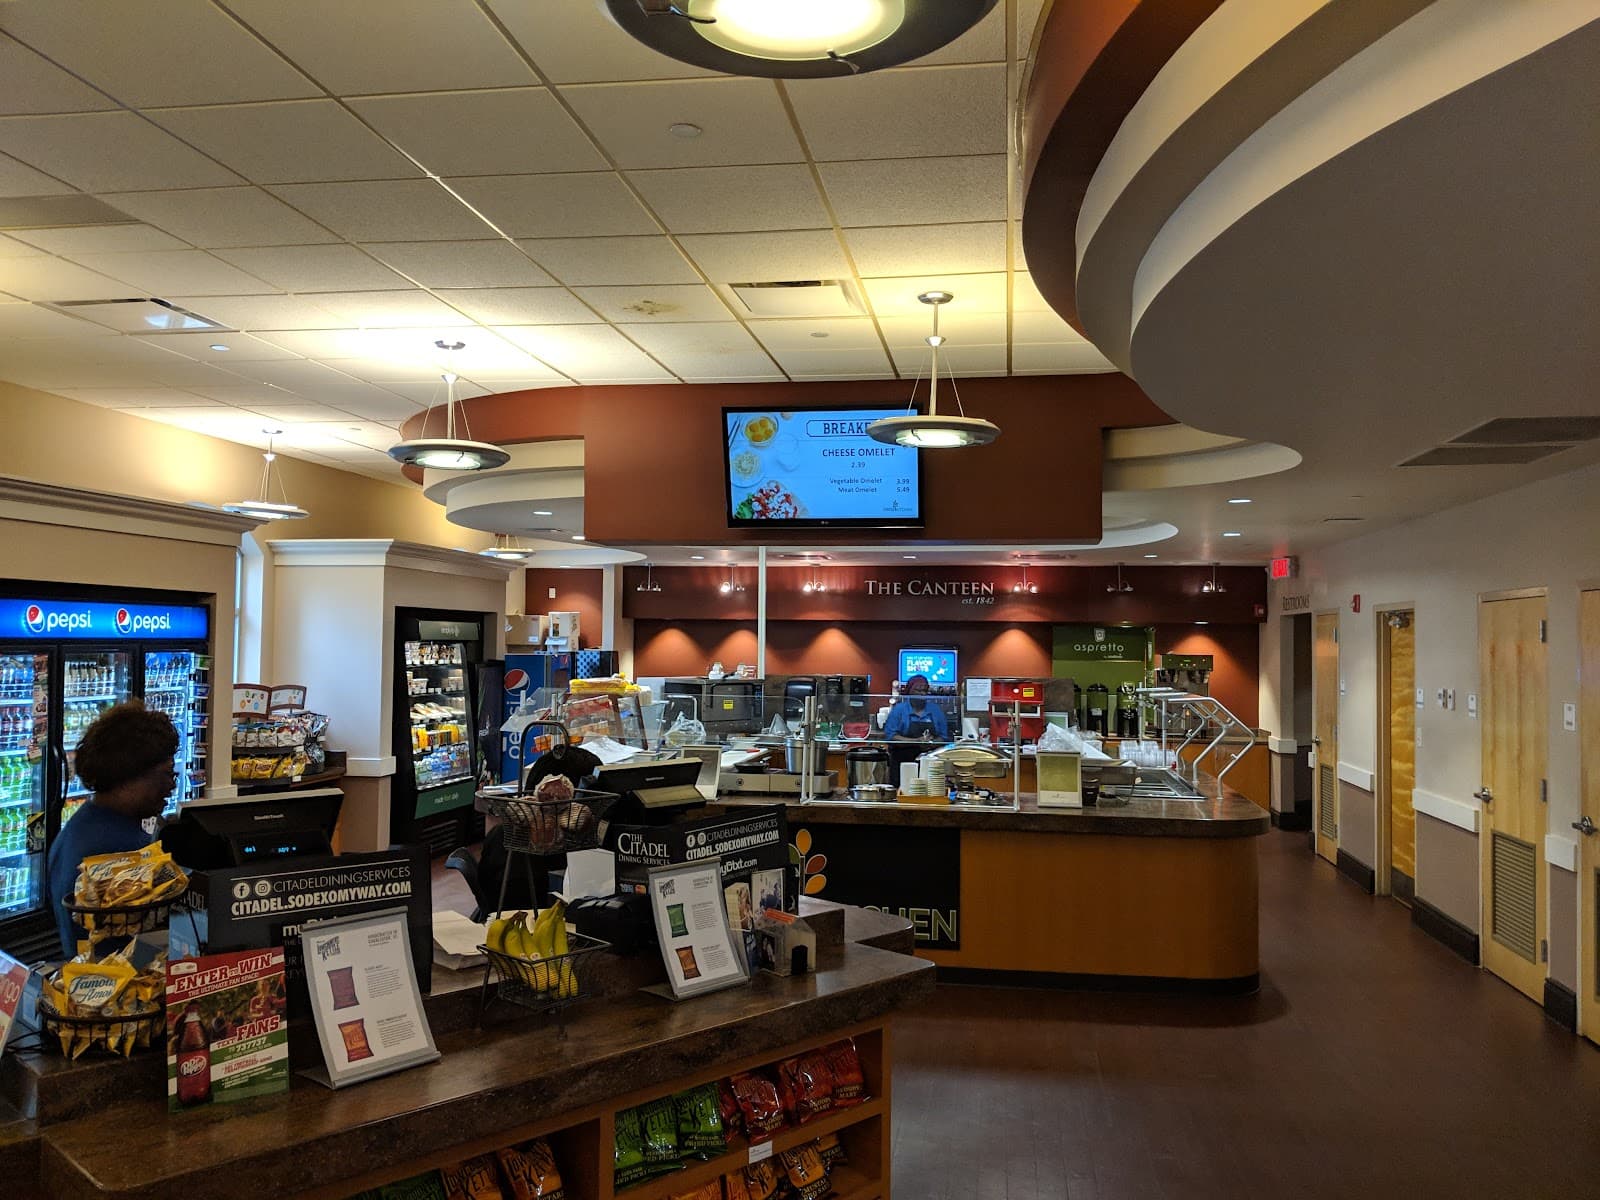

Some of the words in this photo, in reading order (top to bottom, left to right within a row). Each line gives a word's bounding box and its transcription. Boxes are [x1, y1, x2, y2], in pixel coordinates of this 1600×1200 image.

[822, 448, 855, 457] CHEESE
[858, 448, 895, 456] OMELET
[864, 580, 902, 596] THE
[907, 580, 995, 596] CANTEEN
[975, 597, 995, 605] 1842
[47, 610, 92, 632] pepsi
[133, 612, 171, 633] pepsi
[1073, 643, 1124, 654] aspretto
[630, 833, 644, 842] THE
[706, 819, 778, 842] CITADELDININGSERVICES
[617, 832, 670, 858] CITADEL
[686, 830, 780, 861] CITADEL.SODEXOMYWAY.COM
[618, 854, 642, 864] DINING
[272, 866, 411, 893] CITADELDININGSERVICES
[231, 881, 412, 917] CITADEL.SODEXOMYWAY.COM
[175, 966, 229, 994] ENTER
[238, 952, 272, 975] WIN
[236, 1014, 281, 1042] FANS
